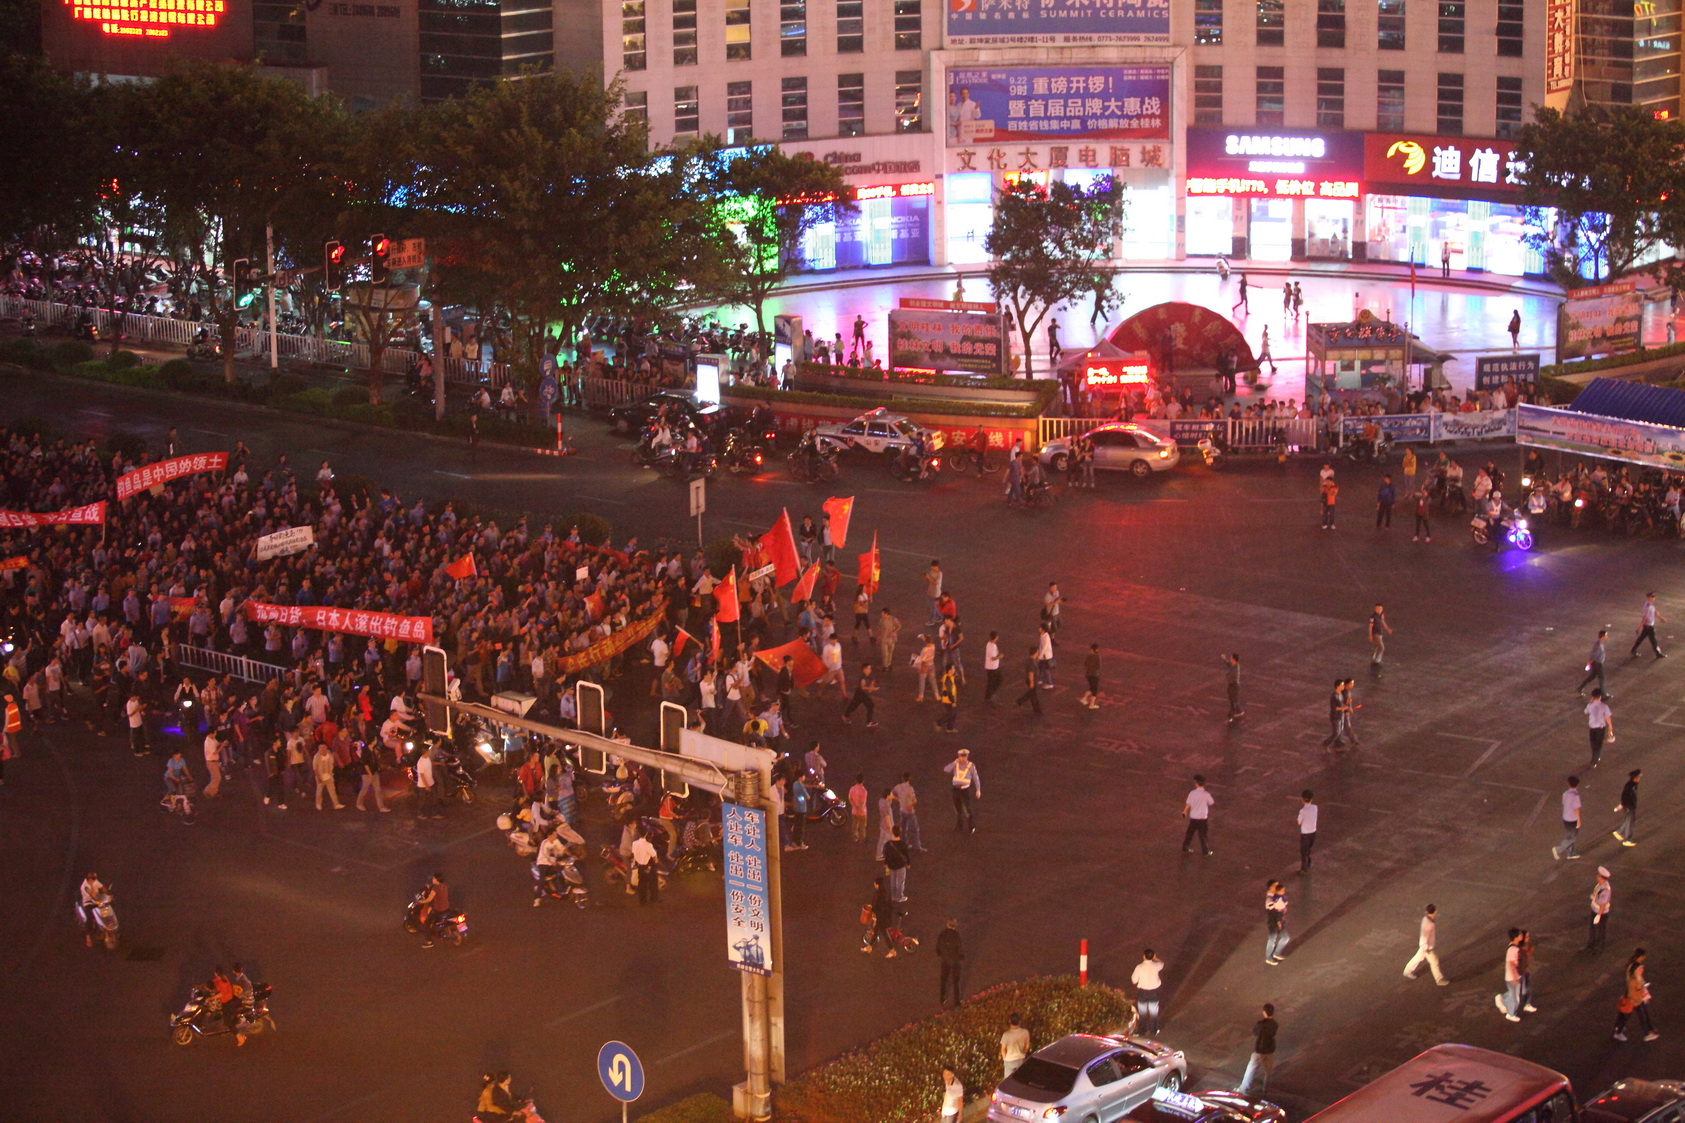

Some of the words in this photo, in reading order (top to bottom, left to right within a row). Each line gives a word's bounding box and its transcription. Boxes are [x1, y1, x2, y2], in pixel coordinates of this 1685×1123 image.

[1040, 10, 1093, 18] SUMMIT
[1099, 10, 1169, 18] CERAMICS
[1009, 76, 1027, 85] 9.22
[1008, 96, 1161, 118] 暨首届品牌大惠战
[824, 151, 862, 165] China
[957, 145, 1164, 171] 文化大厦电脑城
[1225, 134, 1326, 158] SAMSUNG
[117, 455, 223, 498] 钓鱼岛是中国的领土
[726, 807, 743, 846] 人让车
[744, 810, 761, 851] 车让人
[728, 851, 746, 929] 让出一份安全
[746, 855, 764, 933] 让出一份文明
[1409, 1071, 1492, 1110] 桂
